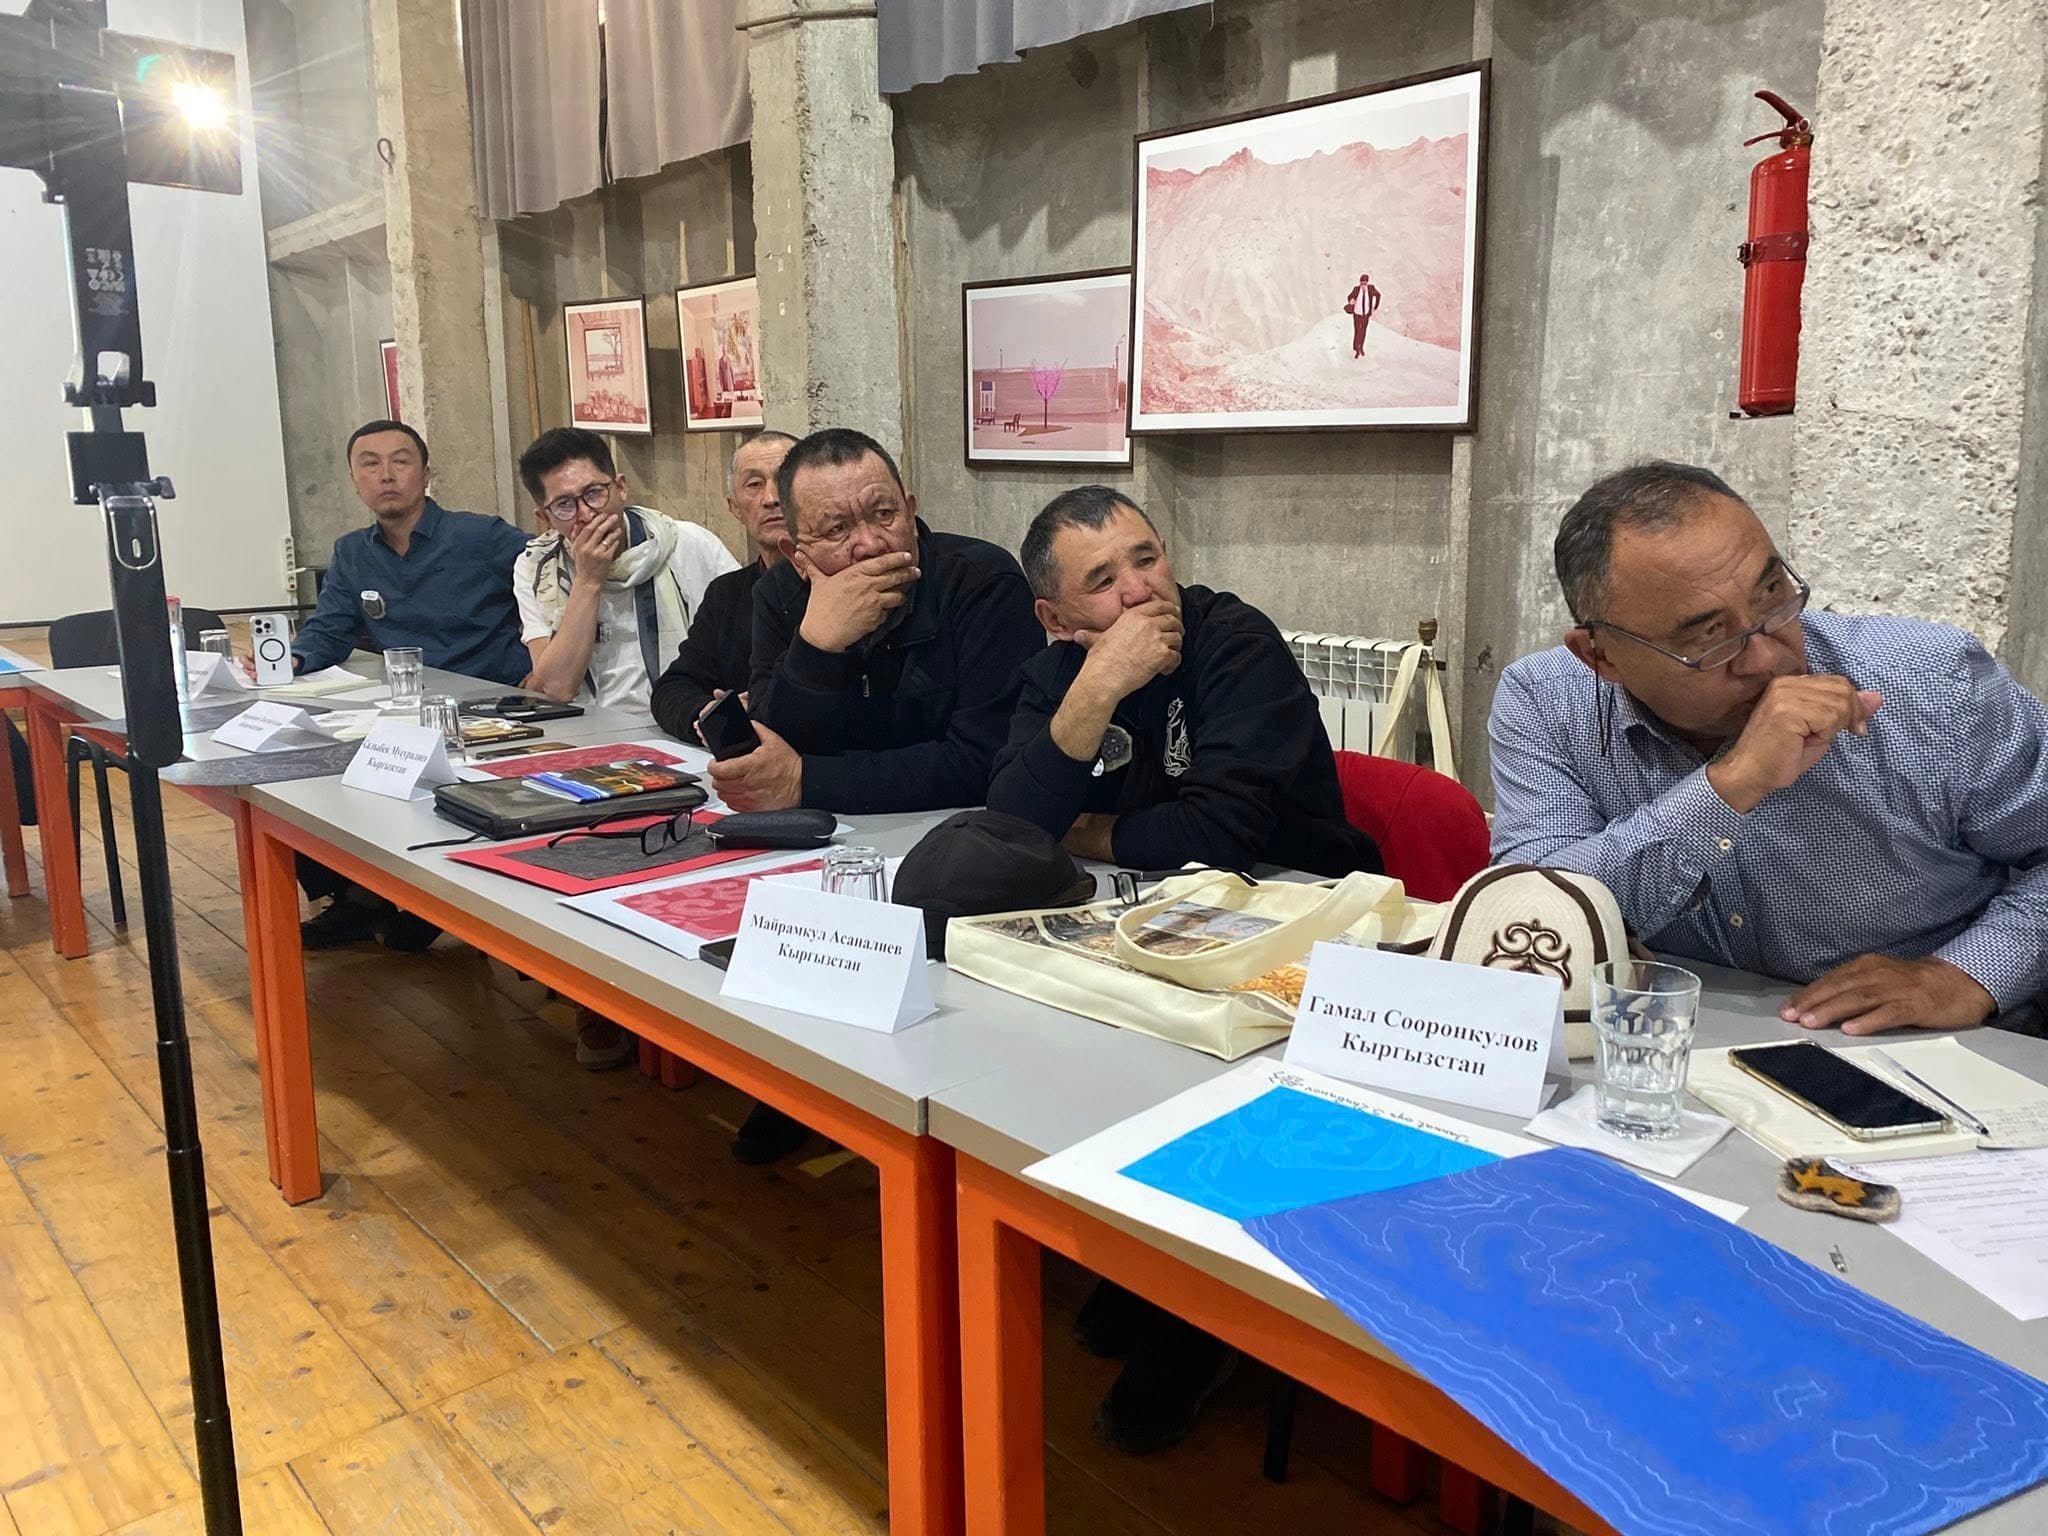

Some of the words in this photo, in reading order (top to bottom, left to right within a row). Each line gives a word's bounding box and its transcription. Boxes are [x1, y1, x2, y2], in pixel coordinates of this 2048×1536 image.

[367, 757, 407, 774] Кыргызстан
[750, 914, 826, 942] Майрамкул
[829, 929, 903, 956] Асаналиев
[777, 942, 863, 972] Кыргызстан
[1308, 995, 1376, 1024] Гамал
[1383, 1008, 1539, 1053] Сооронкулов
[1340, 1031, 1486, 1076] Кыргызстан
